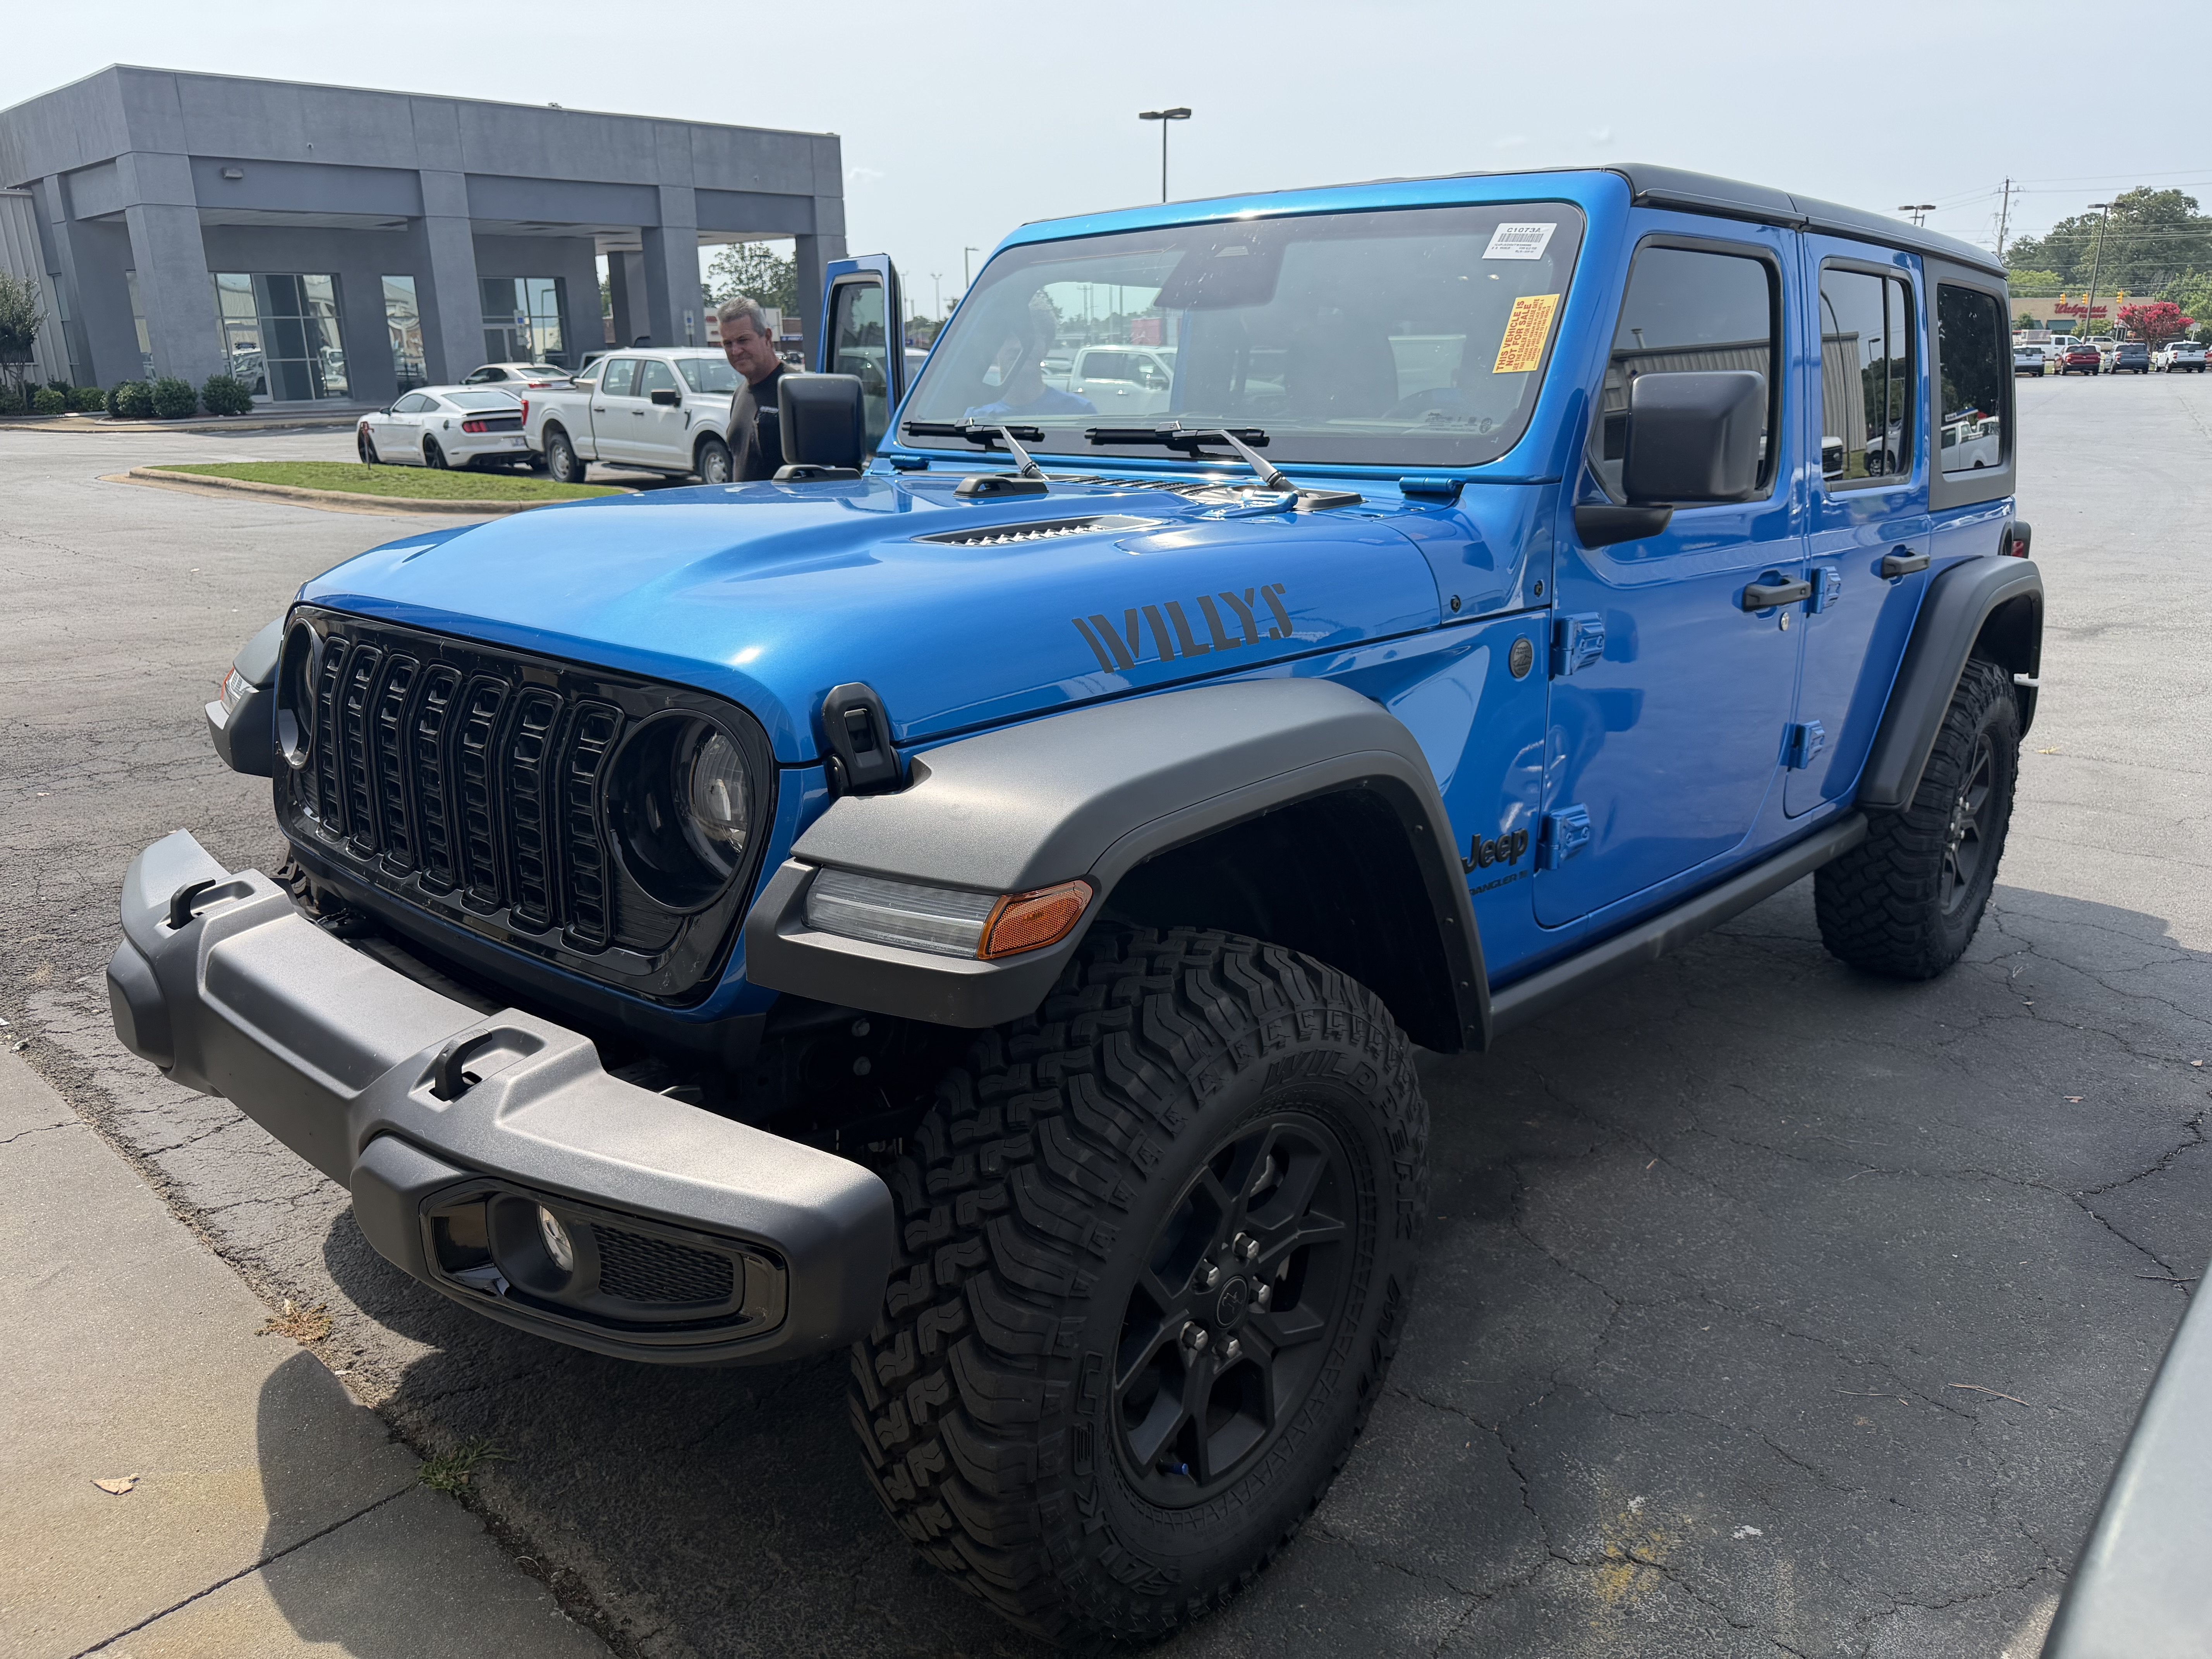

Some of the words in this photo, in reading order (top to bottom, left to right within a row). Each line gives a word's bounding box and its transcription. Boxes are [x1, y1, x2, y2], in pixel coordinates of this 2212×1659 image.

[1518, 304, 1532, 325] SALE
[1518, 337, 1527, 352] DEALER
[1526, 309, 1536, 327] RELEASE
[1531, 299, 1540, 309] DATE
[1496, 350, 1509, 371] THIS
[1503, 311, 1521, 348] VEHICLE
[1515, 301, 1525, 309] IS
[1511, 328, 1524, 345] FOR
[1505, 348, 1518, 366] NOT
[1072, 583, 1293, 673] WILLYS
[1461, 828, 1528, 874] Jeep
[1469, 873, 1517, 896] RANGLER
